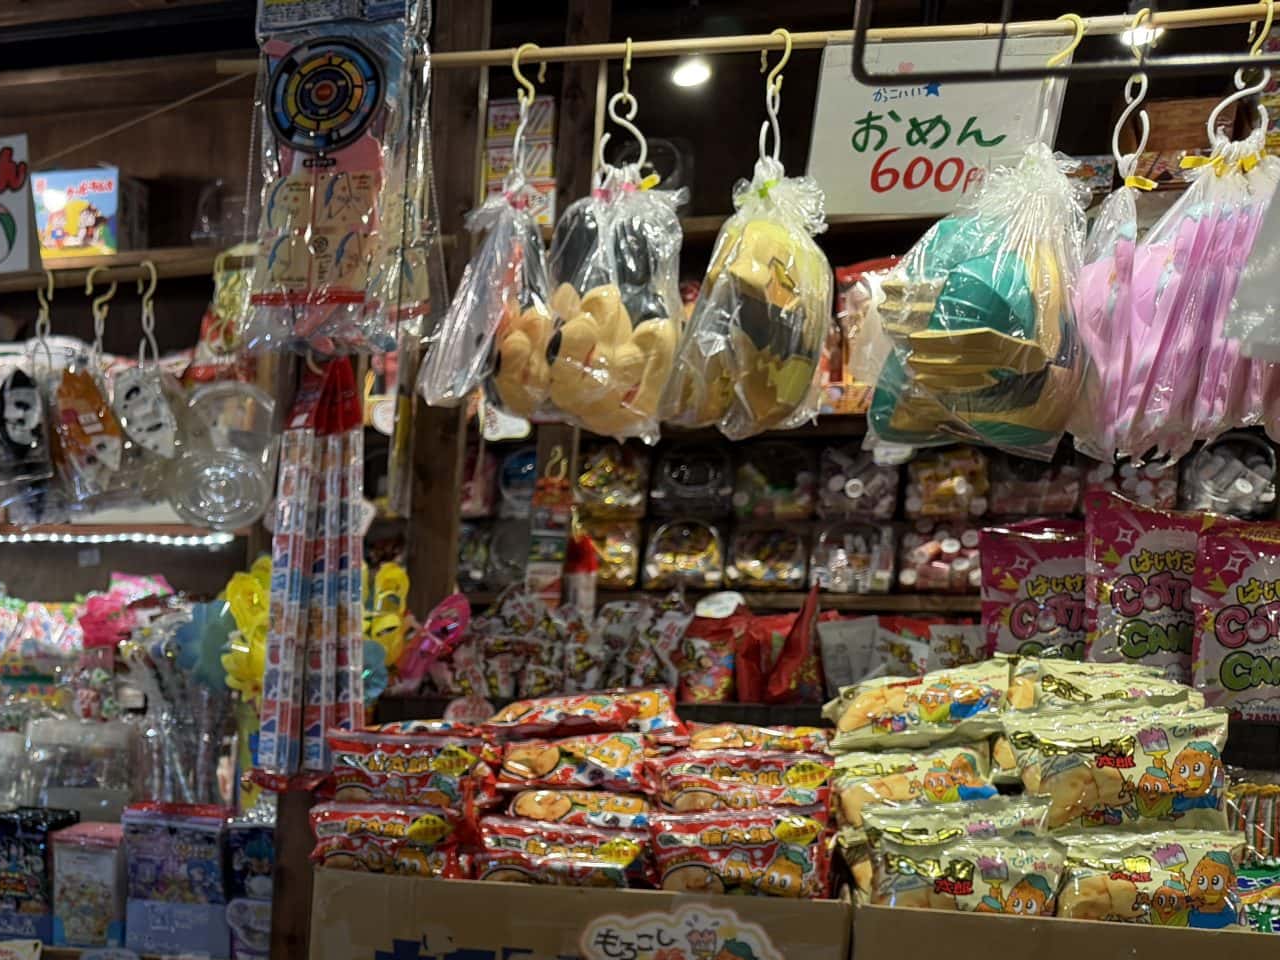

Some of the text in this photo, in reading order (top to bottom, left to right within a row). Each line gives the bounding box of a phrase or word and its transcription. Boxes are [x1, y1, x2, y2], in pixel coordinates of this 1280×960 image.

[851, 110, 1008, 152] おめん
[1130, 548, 1196, 575] はじける
[594, 927, 677, 960] もろこし
